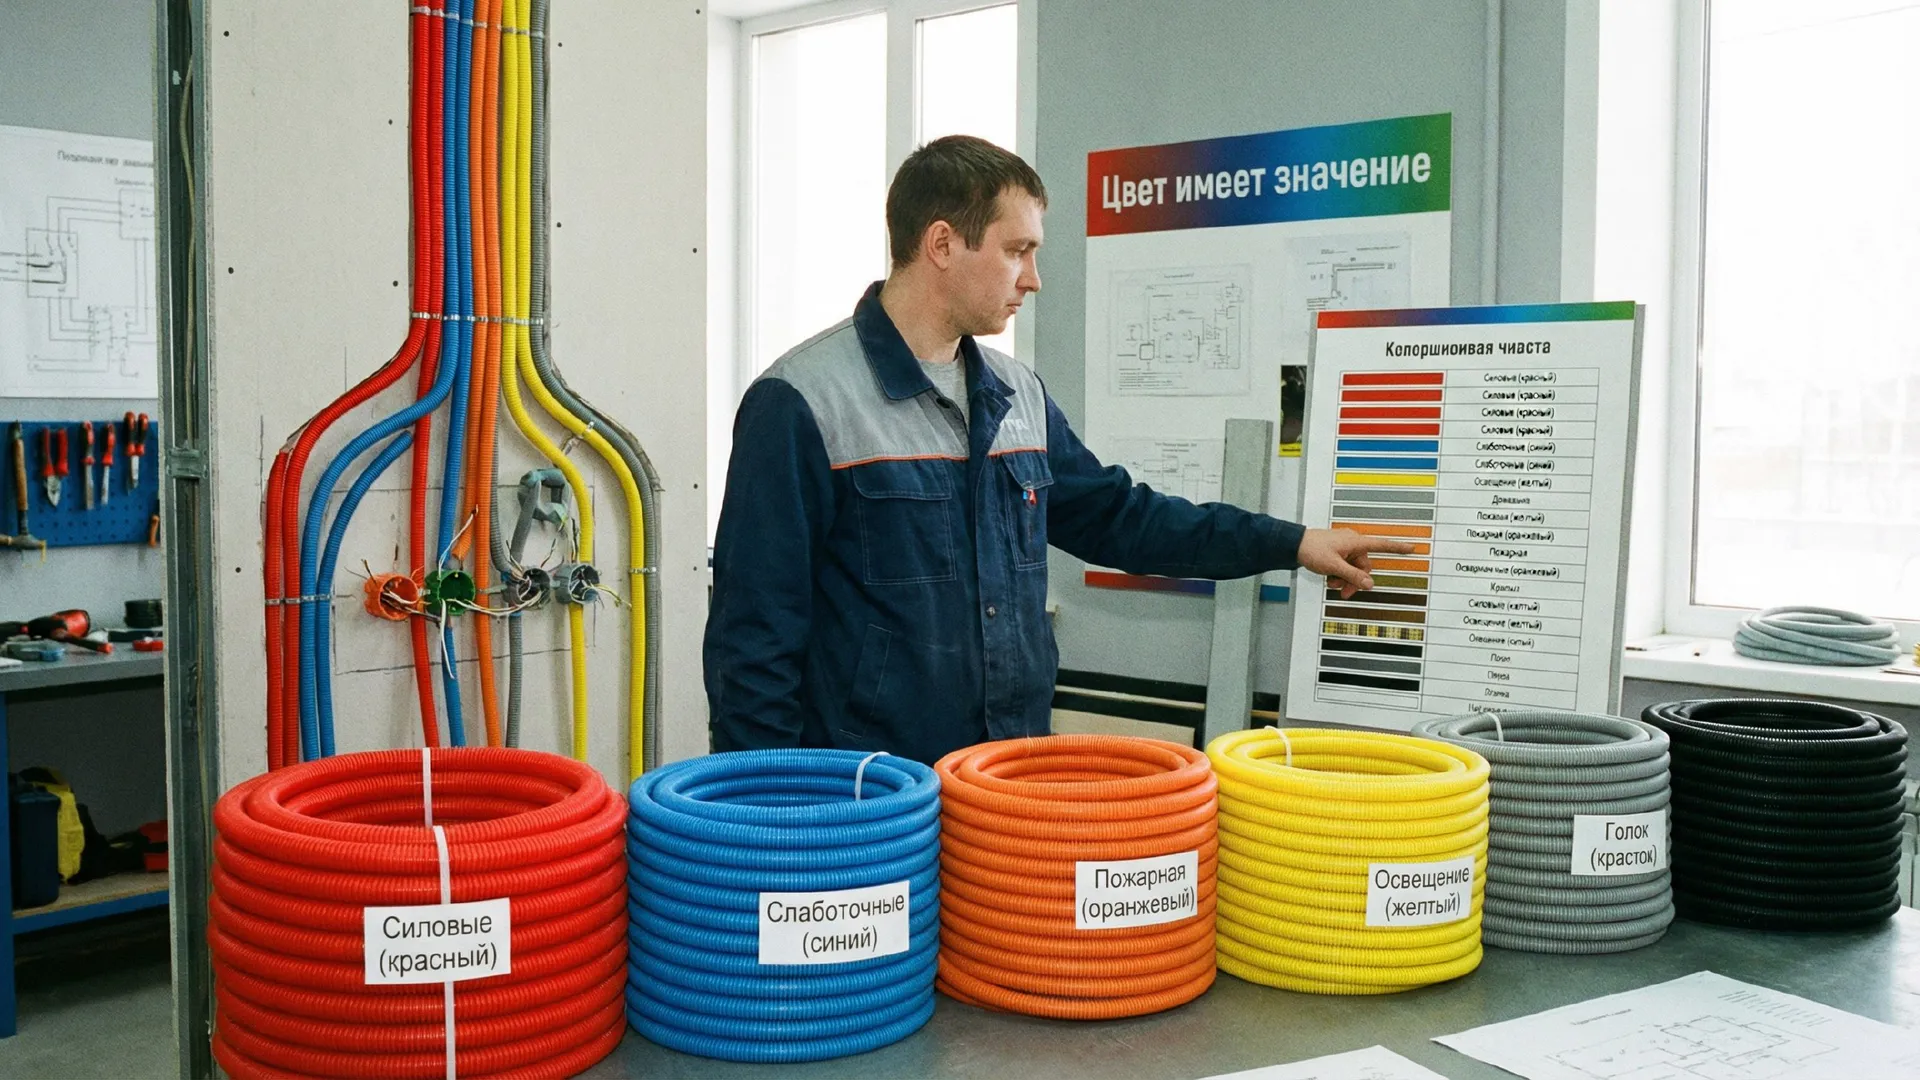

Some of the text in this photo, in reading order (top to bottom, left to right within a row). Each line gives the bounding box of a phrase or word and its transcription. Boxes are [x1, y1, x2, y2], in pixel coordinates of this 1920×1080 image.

[1102, 150, 1432, 213] Цвет имеет значение
[1604, 821, 1649, 843] Голок
[1590, 845, 1658, 872] (красток)
[1095, 864, 1186, 891] Пожарная
[1374, 865, 1470, 894] Освещение
[766, 891, 906, 924] Слаботочные
[1081, 886, 1196, 923] (оранжевый)
[1384, 893, 1461, 922] (желтый)
[382, 914, 493, 941] Силовые
[801, 927, 878, 958] (синий)
[378, 944, 498, 978] (красный)
